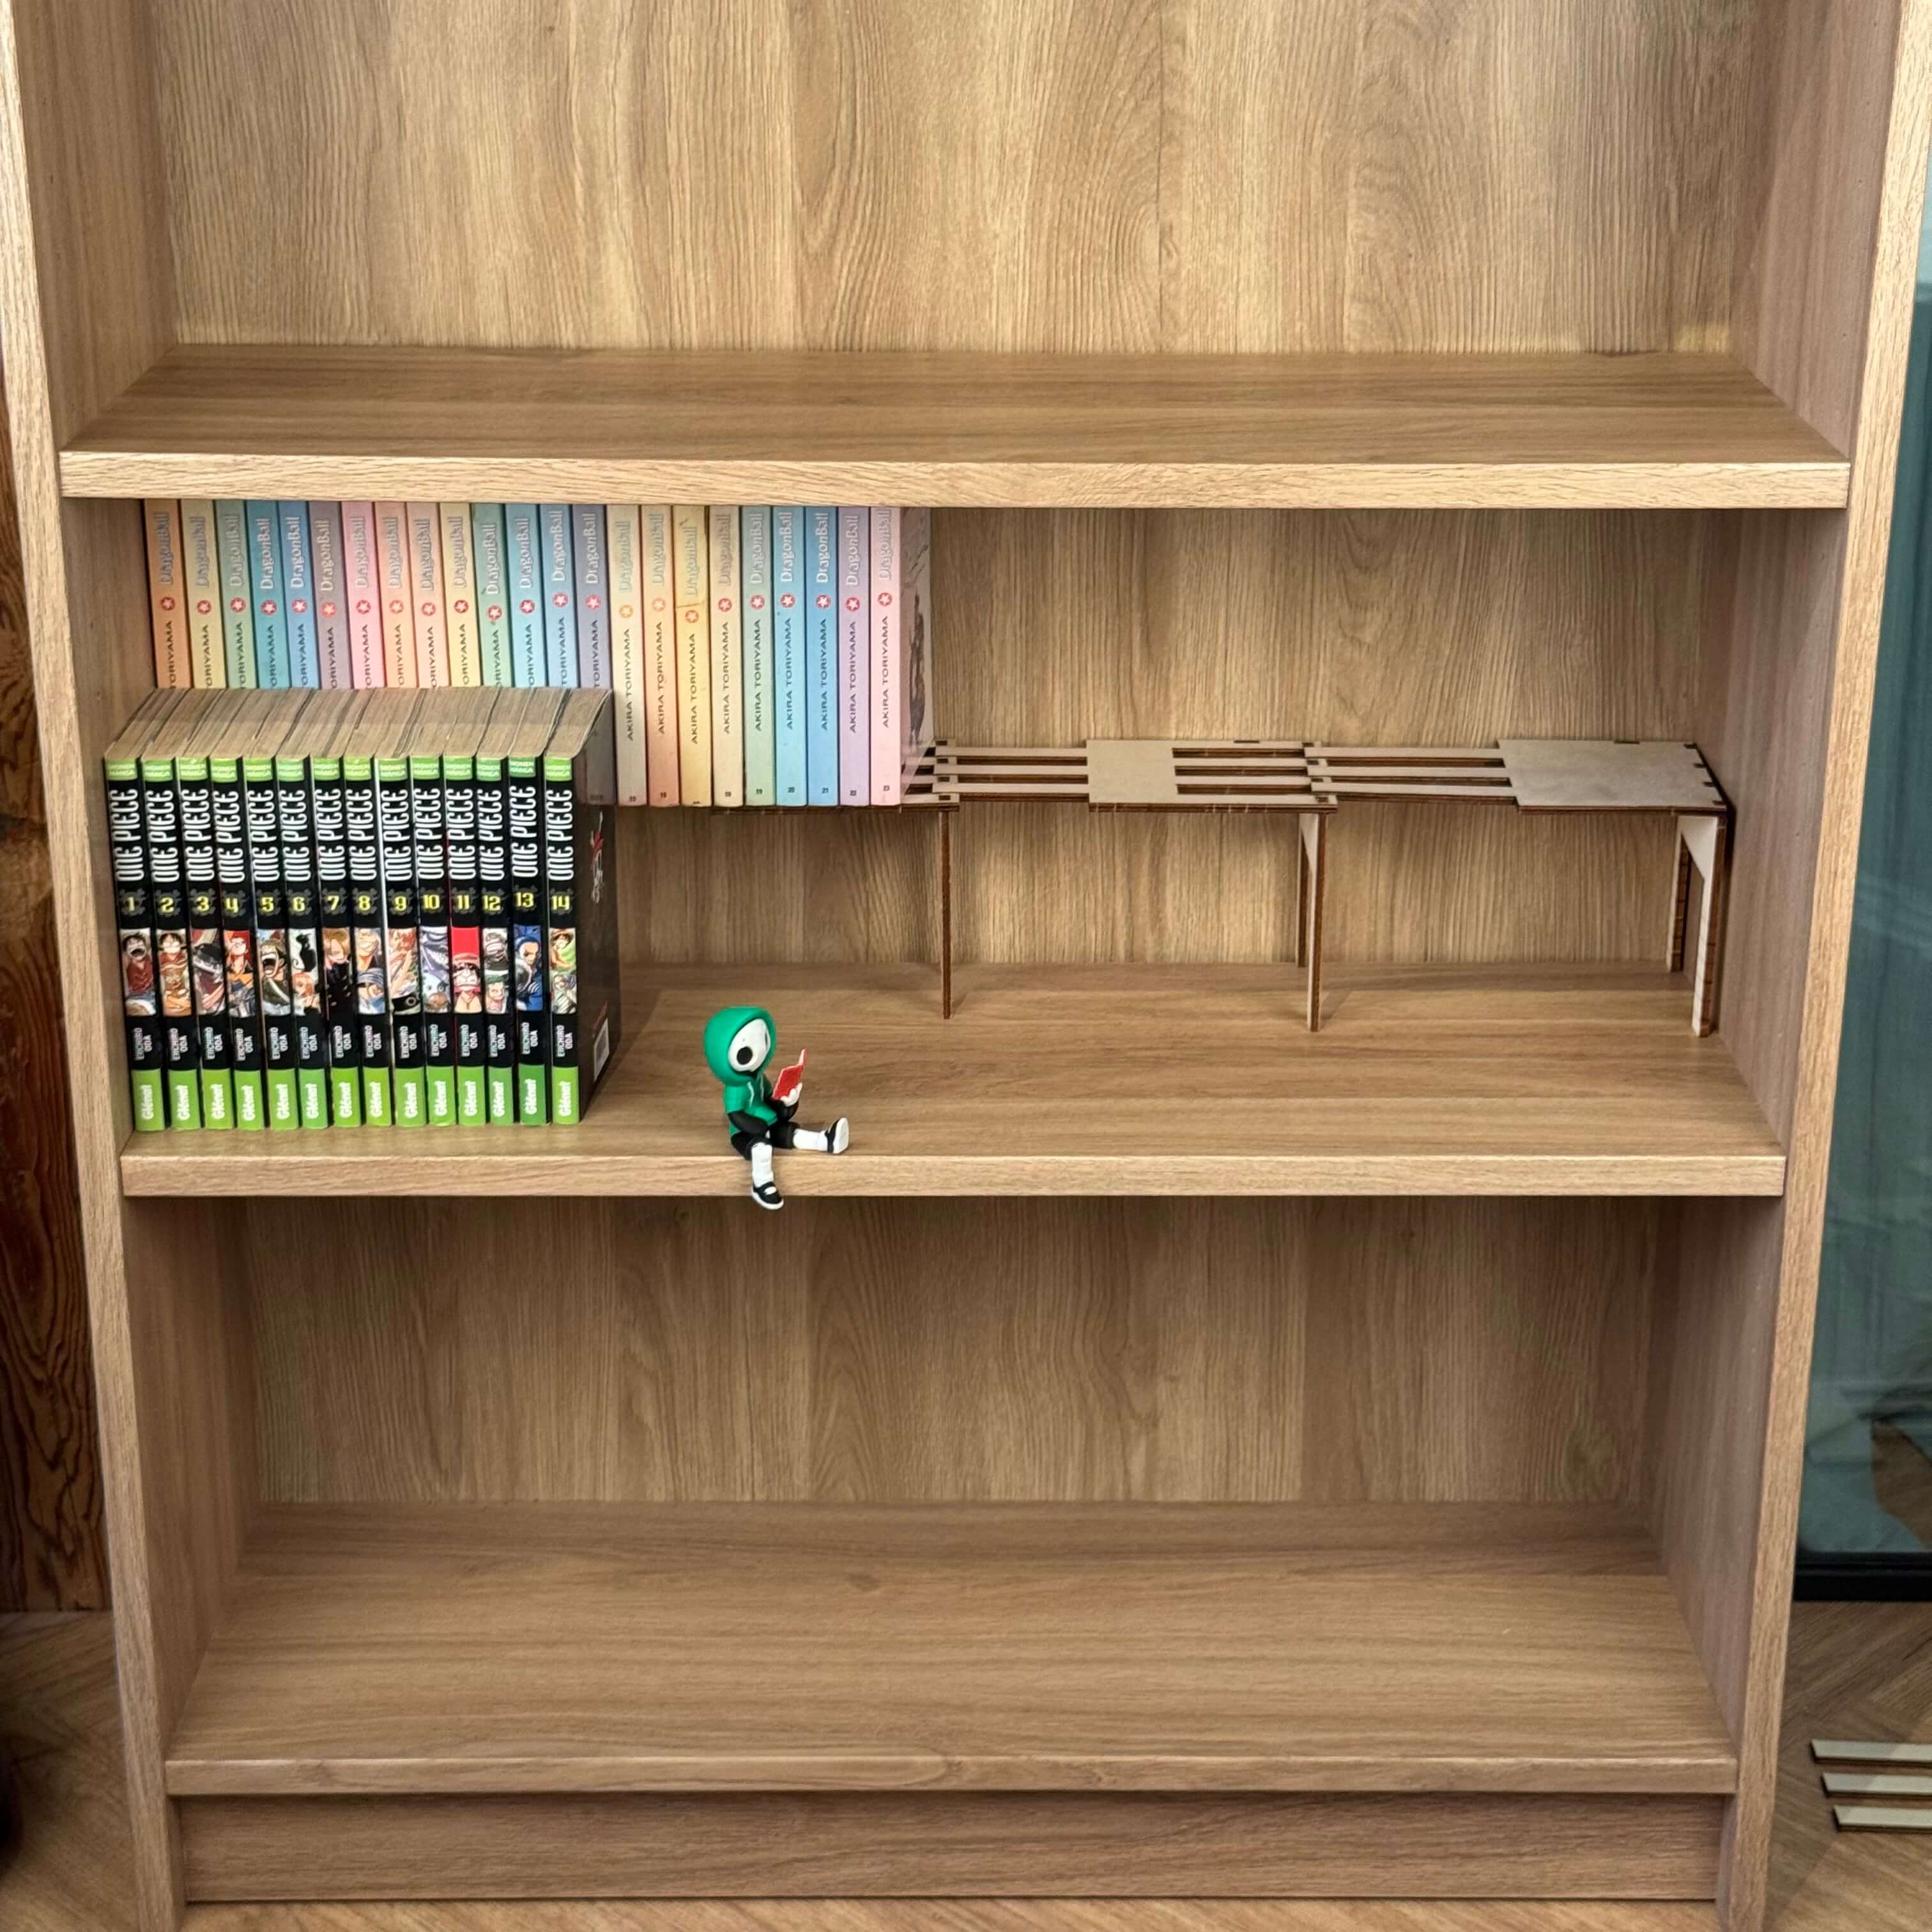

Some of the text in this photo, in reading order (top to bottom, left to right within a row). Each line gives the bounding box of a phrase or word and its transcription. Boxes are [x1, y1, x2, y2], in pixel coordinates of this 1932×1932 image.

[256, 518, 275, 590] DragonBall
[286, 516, 305, 588] DragonBall
[315, 520, 334, 592] DragonBall
[480, 523, 500, 595] DragonBall
[516, 517, 535, 588] DragonBall
[549, 510, 567, 582] DragonBall
[582, 513, 601, 584] DragonBall
[749, 513, 765, 583] DragonBall
[779, 512, 794, 582] DragonBall
[815, 512, 830, 583] DragonBall
[845, 514, 860, 585] DragonBall
[203, 624, 213, 687] ORIYAMA
[266, 625, 277, 687] ORIYAMA
[297, 623, 308, 686] ORIYAMA
[327, 627, 338, 688] ORIYAMA
[361, 624, 372, 687] ORIYAMA
[395, 624, 405, 686] ORIYAMA
[426, 626, 438, 687] ORIYAMA
[459, 624, 470, 686] ORIYAMA
[524, 624, 535, 687] ORIYAMA
[557, 617, 568, 687] TORIYAMA
[656, 622, 664, 691] TORIYAMA
[753, 619, 762, 688] TORIYAMA
[624, 629, 634, 741] AKIRA TORIYAMA
[109, 789, 141, 841] PIECE
[146, 790, 176, 843] PIECE
[181, 789, 211, 841] PIECE
[213, 790, 242, 843] PIECE
[247, 790, 277, 842] PIECE
[279, 790, 308, 842] PIECE
[315, 788, 344, 841] PIECE
[345, 789, 374, 841] PIECE
[381, 789, 410, 842] PIECE
[413, 788, 442, 841] PIECE
[447, 788, 474, 841] PIECE
[478, 789, 503, 841] PIECE
[510, 785, 538, 878] ONE PIECE
[546, 790, 573, 841] PIECE
[114, 846, 144, 882] ONE
[151, 847, 180, 882] ONE
[185, 846, 215, 882] ONE
[218, 848, 245, 883] ONE
[252, 847, 280, 882] ONE
[283, 847, 310, 882] ONE
[319, 845, 346, 881] ONE
[349, 846, 377, 882] ONE
[384, 847, 413, 882] ONE
[417, 845, 444, 880] ONE
[449, 845, 476, 880] ONE
[480, 845, 505, 881] ONE
[548, 846, 574, 881] ONE
[128, 898, 135, 911] 1
[161, 898, 174, 913] 2
[196, 896, 210, 911] 3
[226, 898, 238, 913] 4
[261, 896, 274, 911] 5
[293, 896, 305, 911] 6
[326, 896, 340, 910] 7
[358, 896, 371, 910] 8
[394, 896, 407, 910] 9
[423, 894, 440, 908] 10
[456, 894, 470, 909] 11
[483, 896, 501, 910] 12
[516, 893, 534, 907] 13
[551, 895, 570, 910] 14
[144, 1034, 153, 1052] ODA
[179, 1035, 188, 1053] ODA
[215, 1034, 223, 1052] ODA
[244, 1036, 254, 1054] ODA
[279, 1034, 288, 1052] ODA
[309, 1034, 318, 1052] ODA
[343, 1032, 351, 1050] ODA
[373, 1032, 381, 1050] ODA
[409, 1032, 417, 1050] ODA
[439, 1032, 447, 1049] ODA
[470, 1032, 478, 1049] ODA
[530, 1030, 538, 1047] ODA
[565, 1032, 573, 1050] ODA
